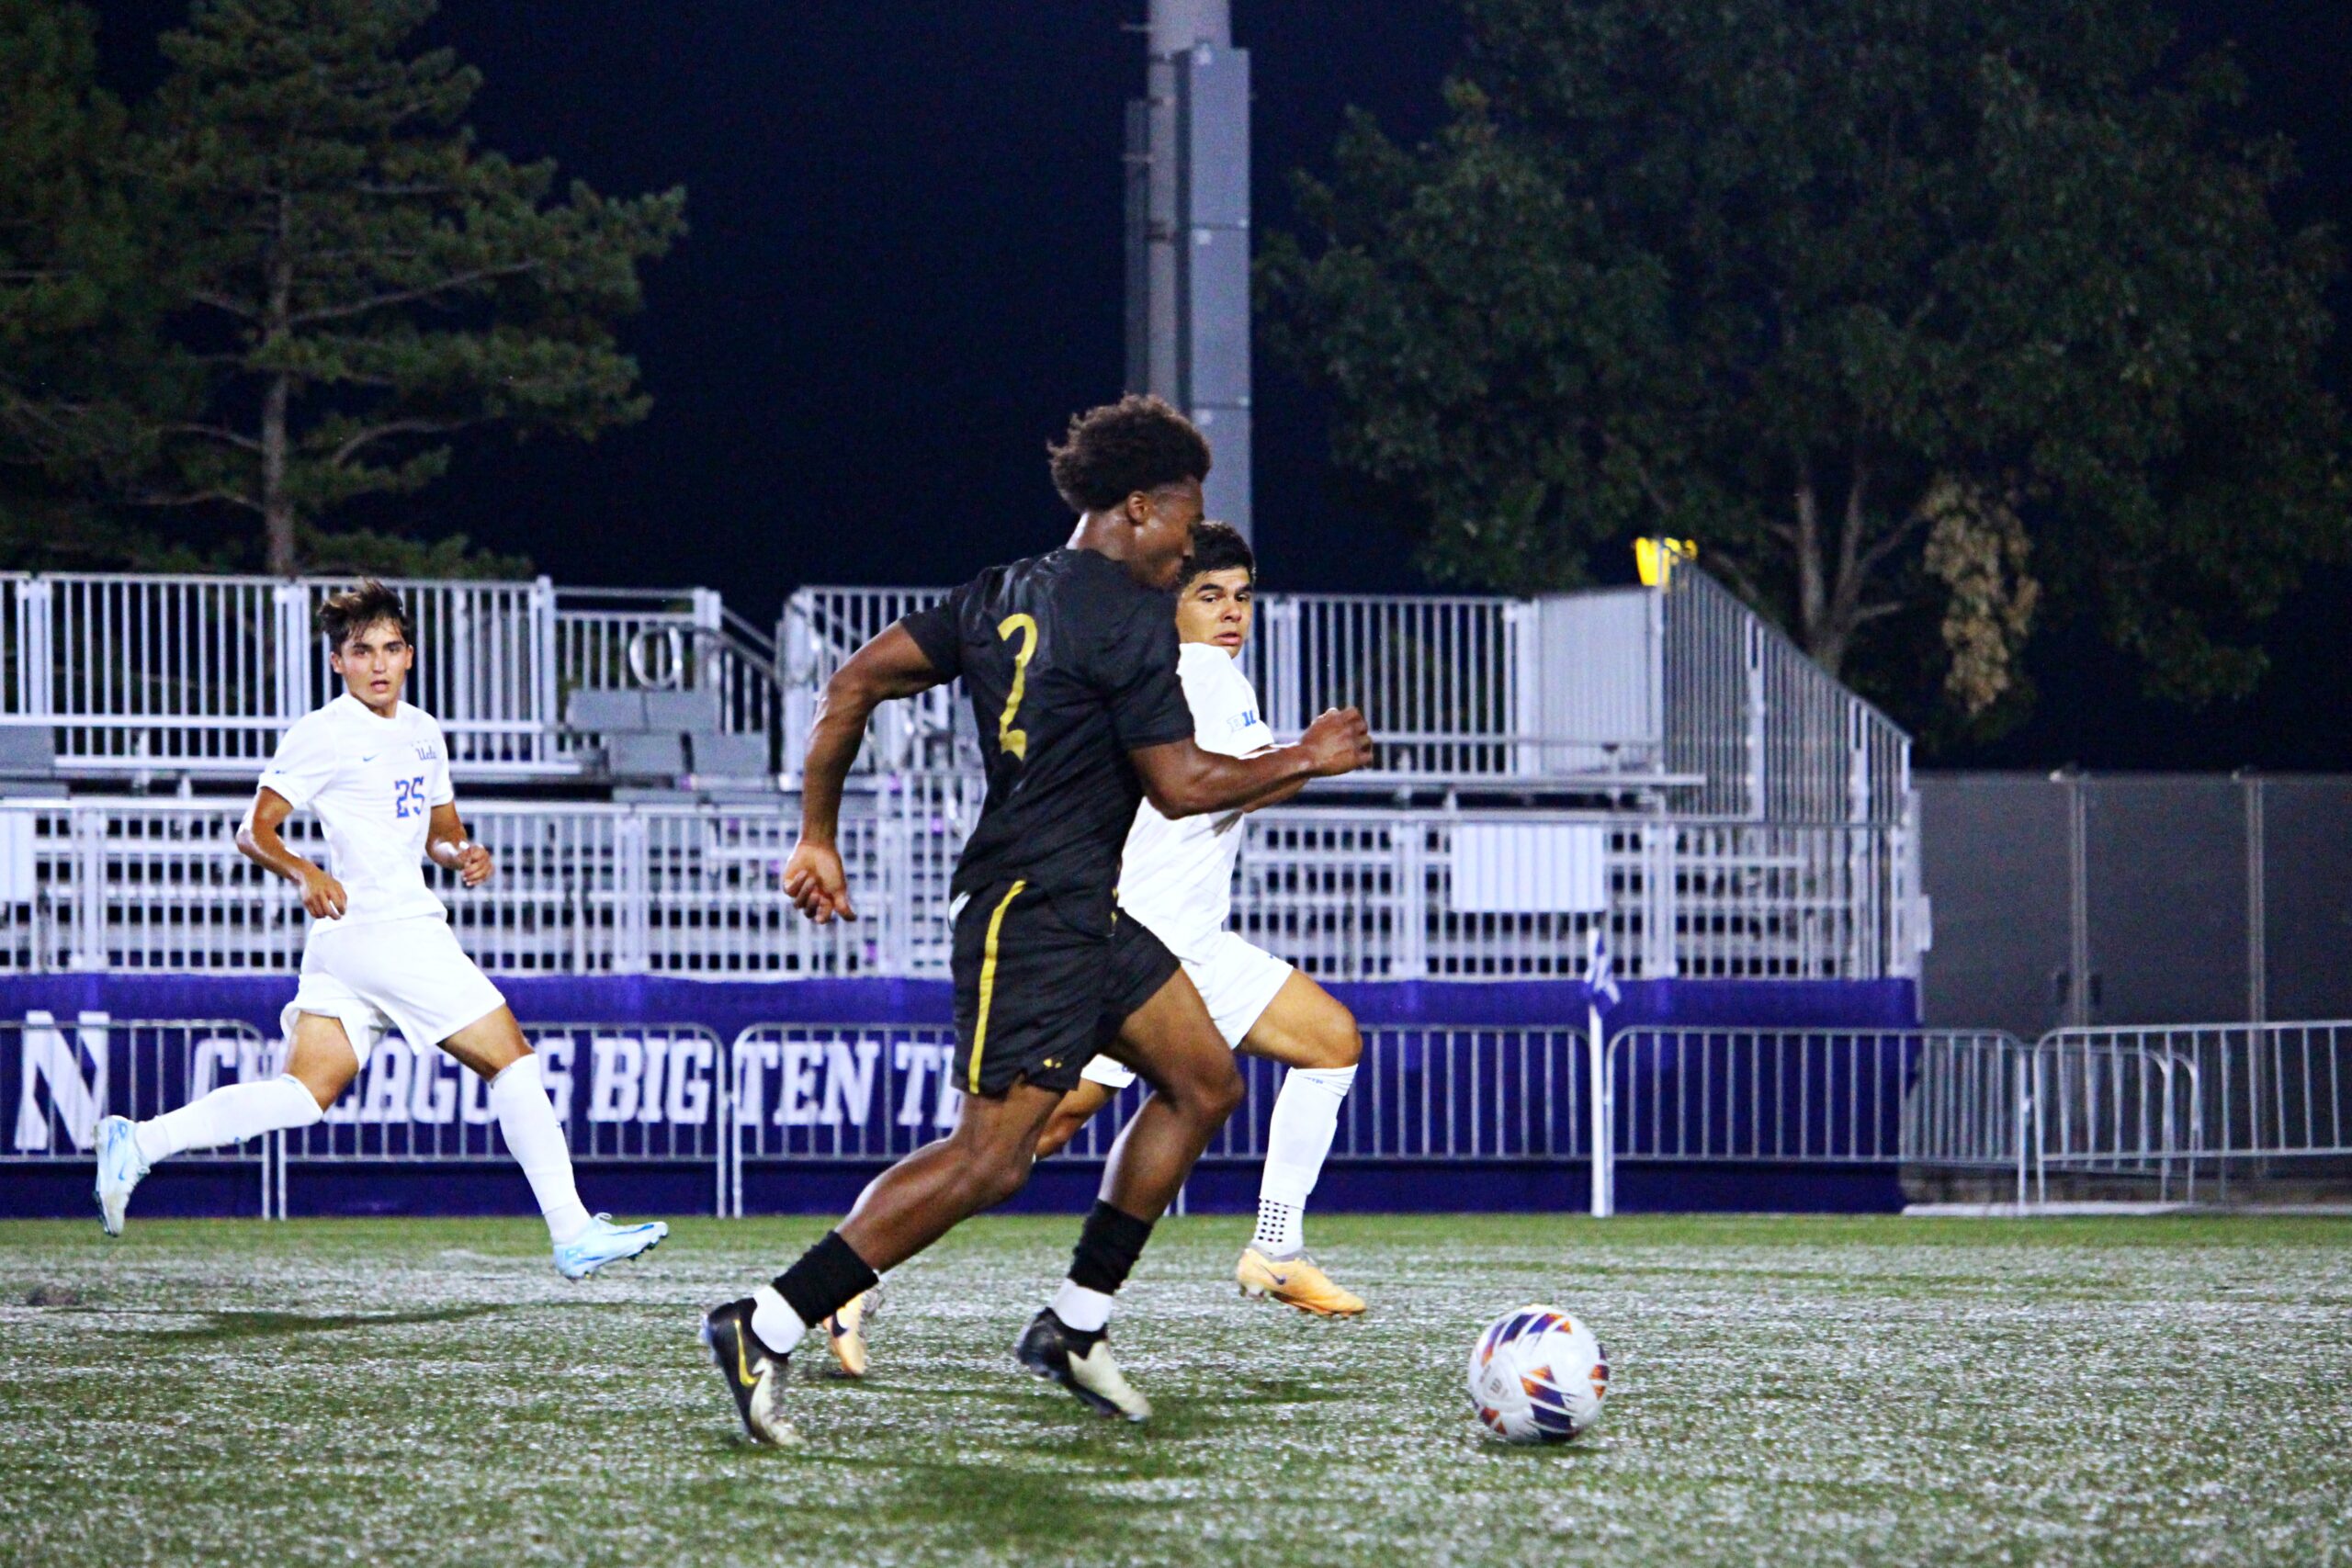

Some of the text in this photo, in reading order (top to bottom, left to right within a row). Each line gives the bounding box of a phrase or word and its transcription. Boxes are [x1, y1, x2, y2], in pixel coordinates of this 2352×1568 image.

[997, 613, 1038, 761] 2
[395, 776, 424, 818] 25
[15, 1010, 109, 1150] N
[587, 1038, 713, 1124] BIG
[738, 1040, 879, 1126] TEN
